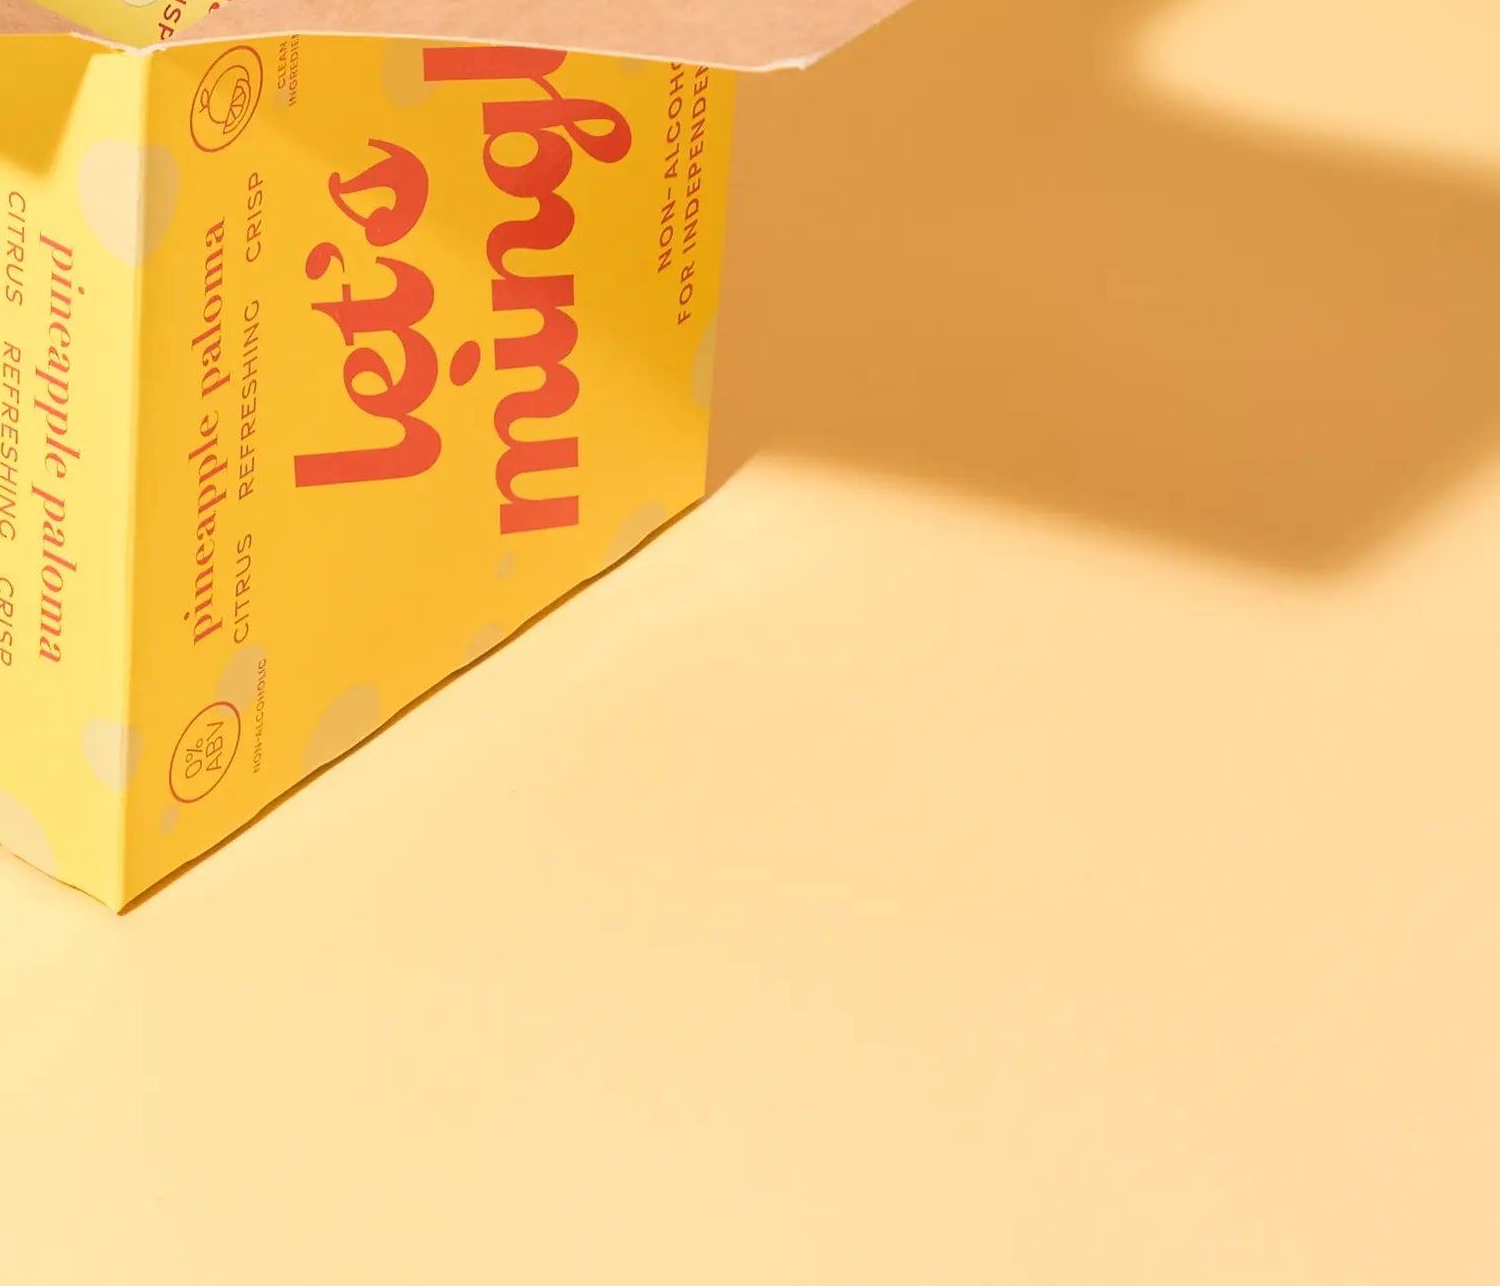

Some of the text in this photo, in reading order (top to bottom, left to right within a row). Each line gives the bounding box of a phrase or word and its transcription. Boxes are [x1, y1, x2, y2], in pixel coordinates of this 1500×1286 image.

[3, 190, 27, 307] CITRUS
[294, 138, 443, 488] let's
[677, 260, 696, 326] FOR
[29, 231, 88, 665] pineapple paloma
[184, 216, 231, 647] pineapple paloma
[234, 171, 265, 645] CITRUS REFRESHING CRISP
[184, 738, 204, 780] 0%
[205, 721, 225, 772] ABV
